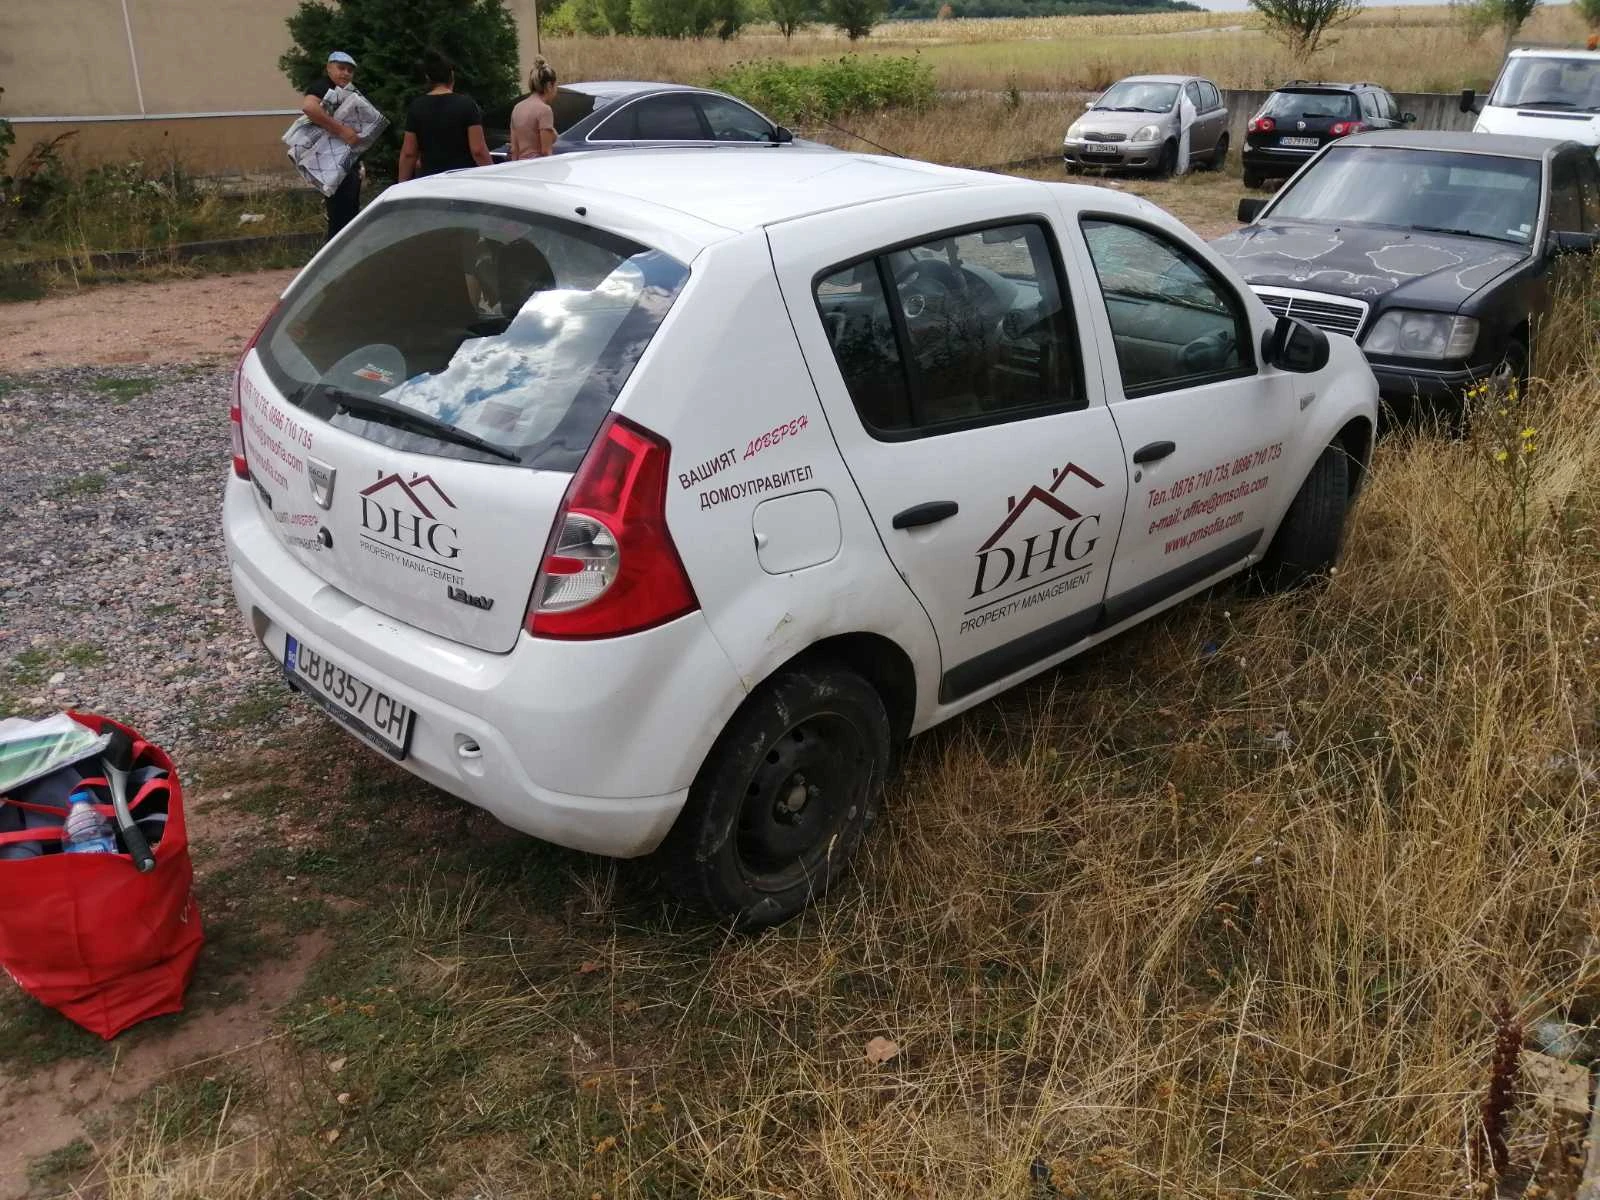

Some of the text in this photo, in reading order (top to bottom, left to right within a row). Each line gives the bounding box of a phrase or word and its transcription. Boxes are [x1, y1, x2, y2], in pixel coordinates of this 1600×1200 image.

[285, 418, 298, 441] 710
[299, 427, 314, 450] 735
[678, 415, 809, 490] ВАШИЯТ ДОВЕРЕН
[700, 465, 813, 511] ДОМОУПРАВИТЕЛ
[1195, 468, 1213, 490] 710
[1252, 447, 1268, 469] 710
[1268, 442, 1283, 462] 735
[360, 495, 464, 559] DHG
[1164, 511, 1245, 554] www.pmsofia.com
[360, 540, 465, 586] PROPERTY MANAGEMENT
[968, 513, 1101, 599] DHG
[960, 571, 1093, 635] PROPERTY MANAGEMENT
[299, 643, 407, 740] CB 8357 CH
